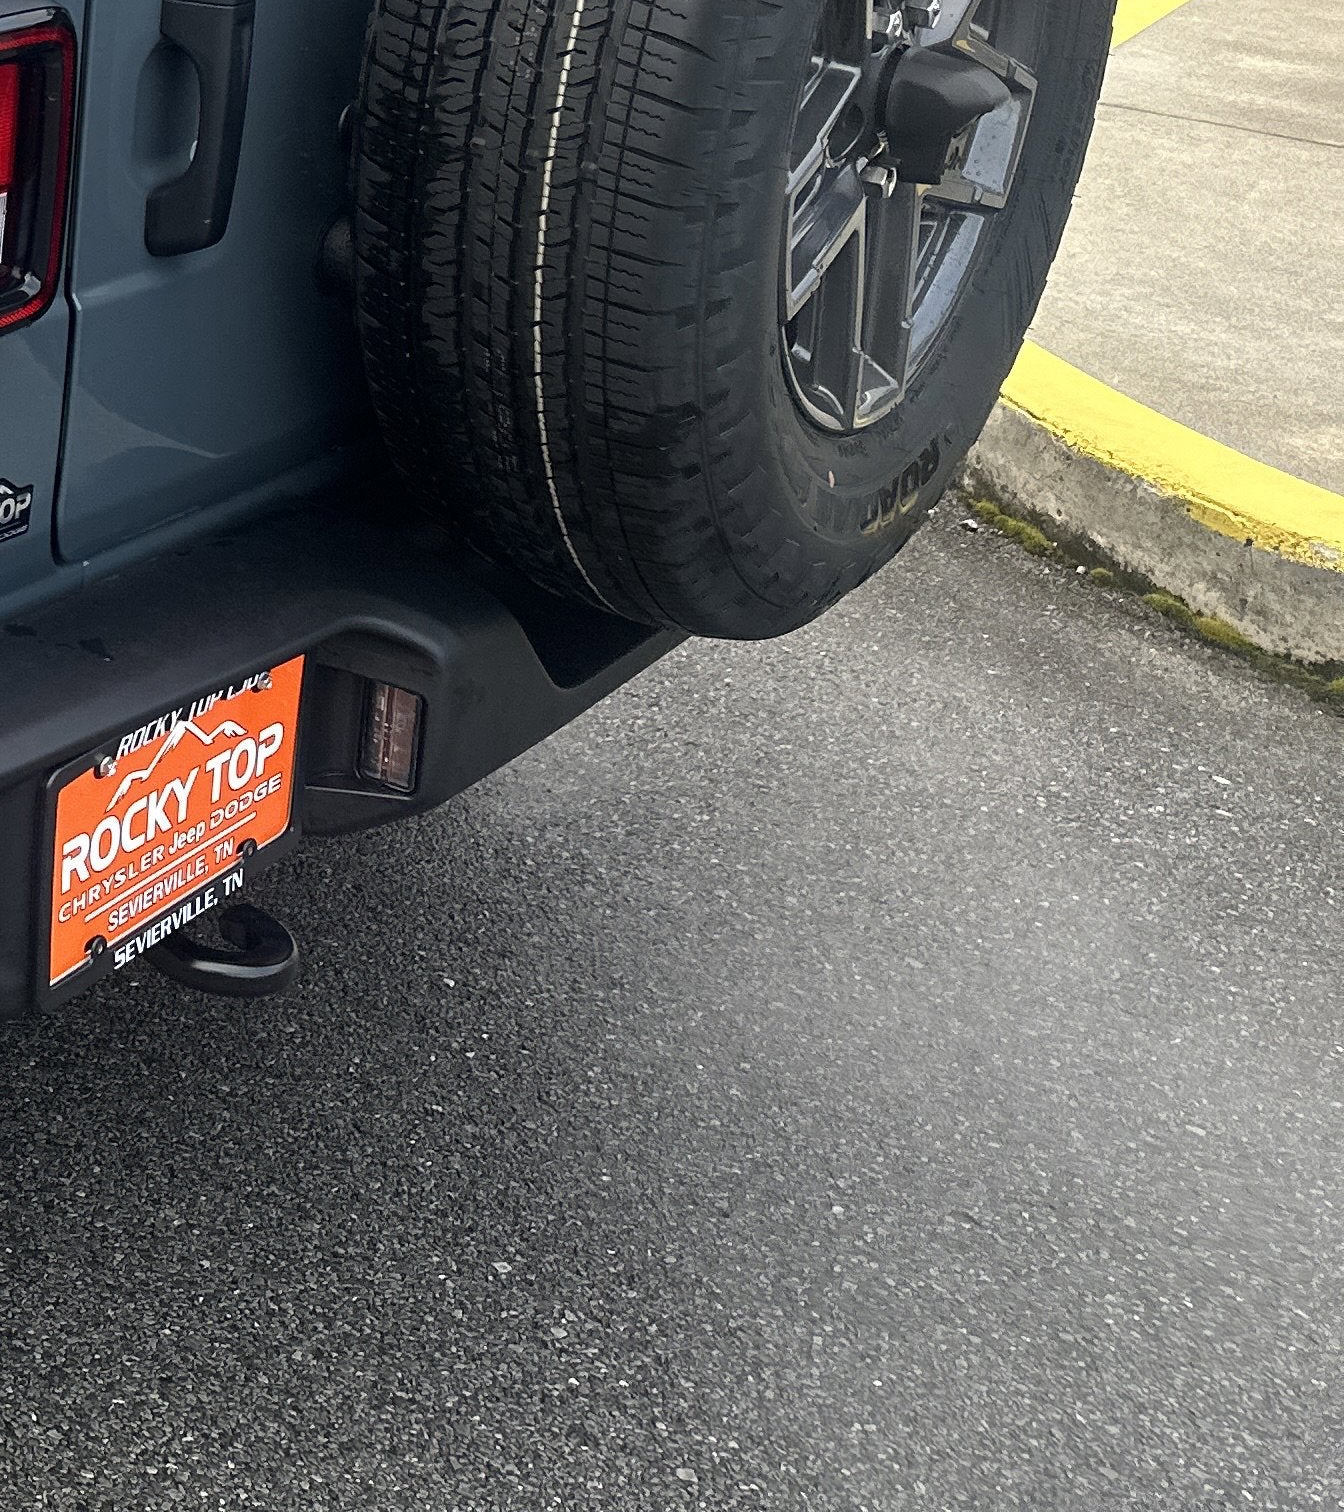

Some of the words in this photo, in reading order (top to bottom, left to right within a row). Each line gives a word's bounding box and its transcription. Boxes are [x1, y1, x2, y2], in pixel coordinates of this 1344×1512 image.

[116, 707, 184, 760] ROCKY
[58, 844, 166, 924] CHRYSLER
[169, 820, 206, 856] Jeep
[210, 772, 282, 830] DODGE
[61, 766, 201, 895] ROCKY
[205, 721, 285, 805] TOP
[107, 854, 210, 933] SEVIERVILLE,
[214, 836, 235, 865] TN
[113, 887, 219, 970] SEVIERVILLE,
[222, 868, 245, 896] TN
